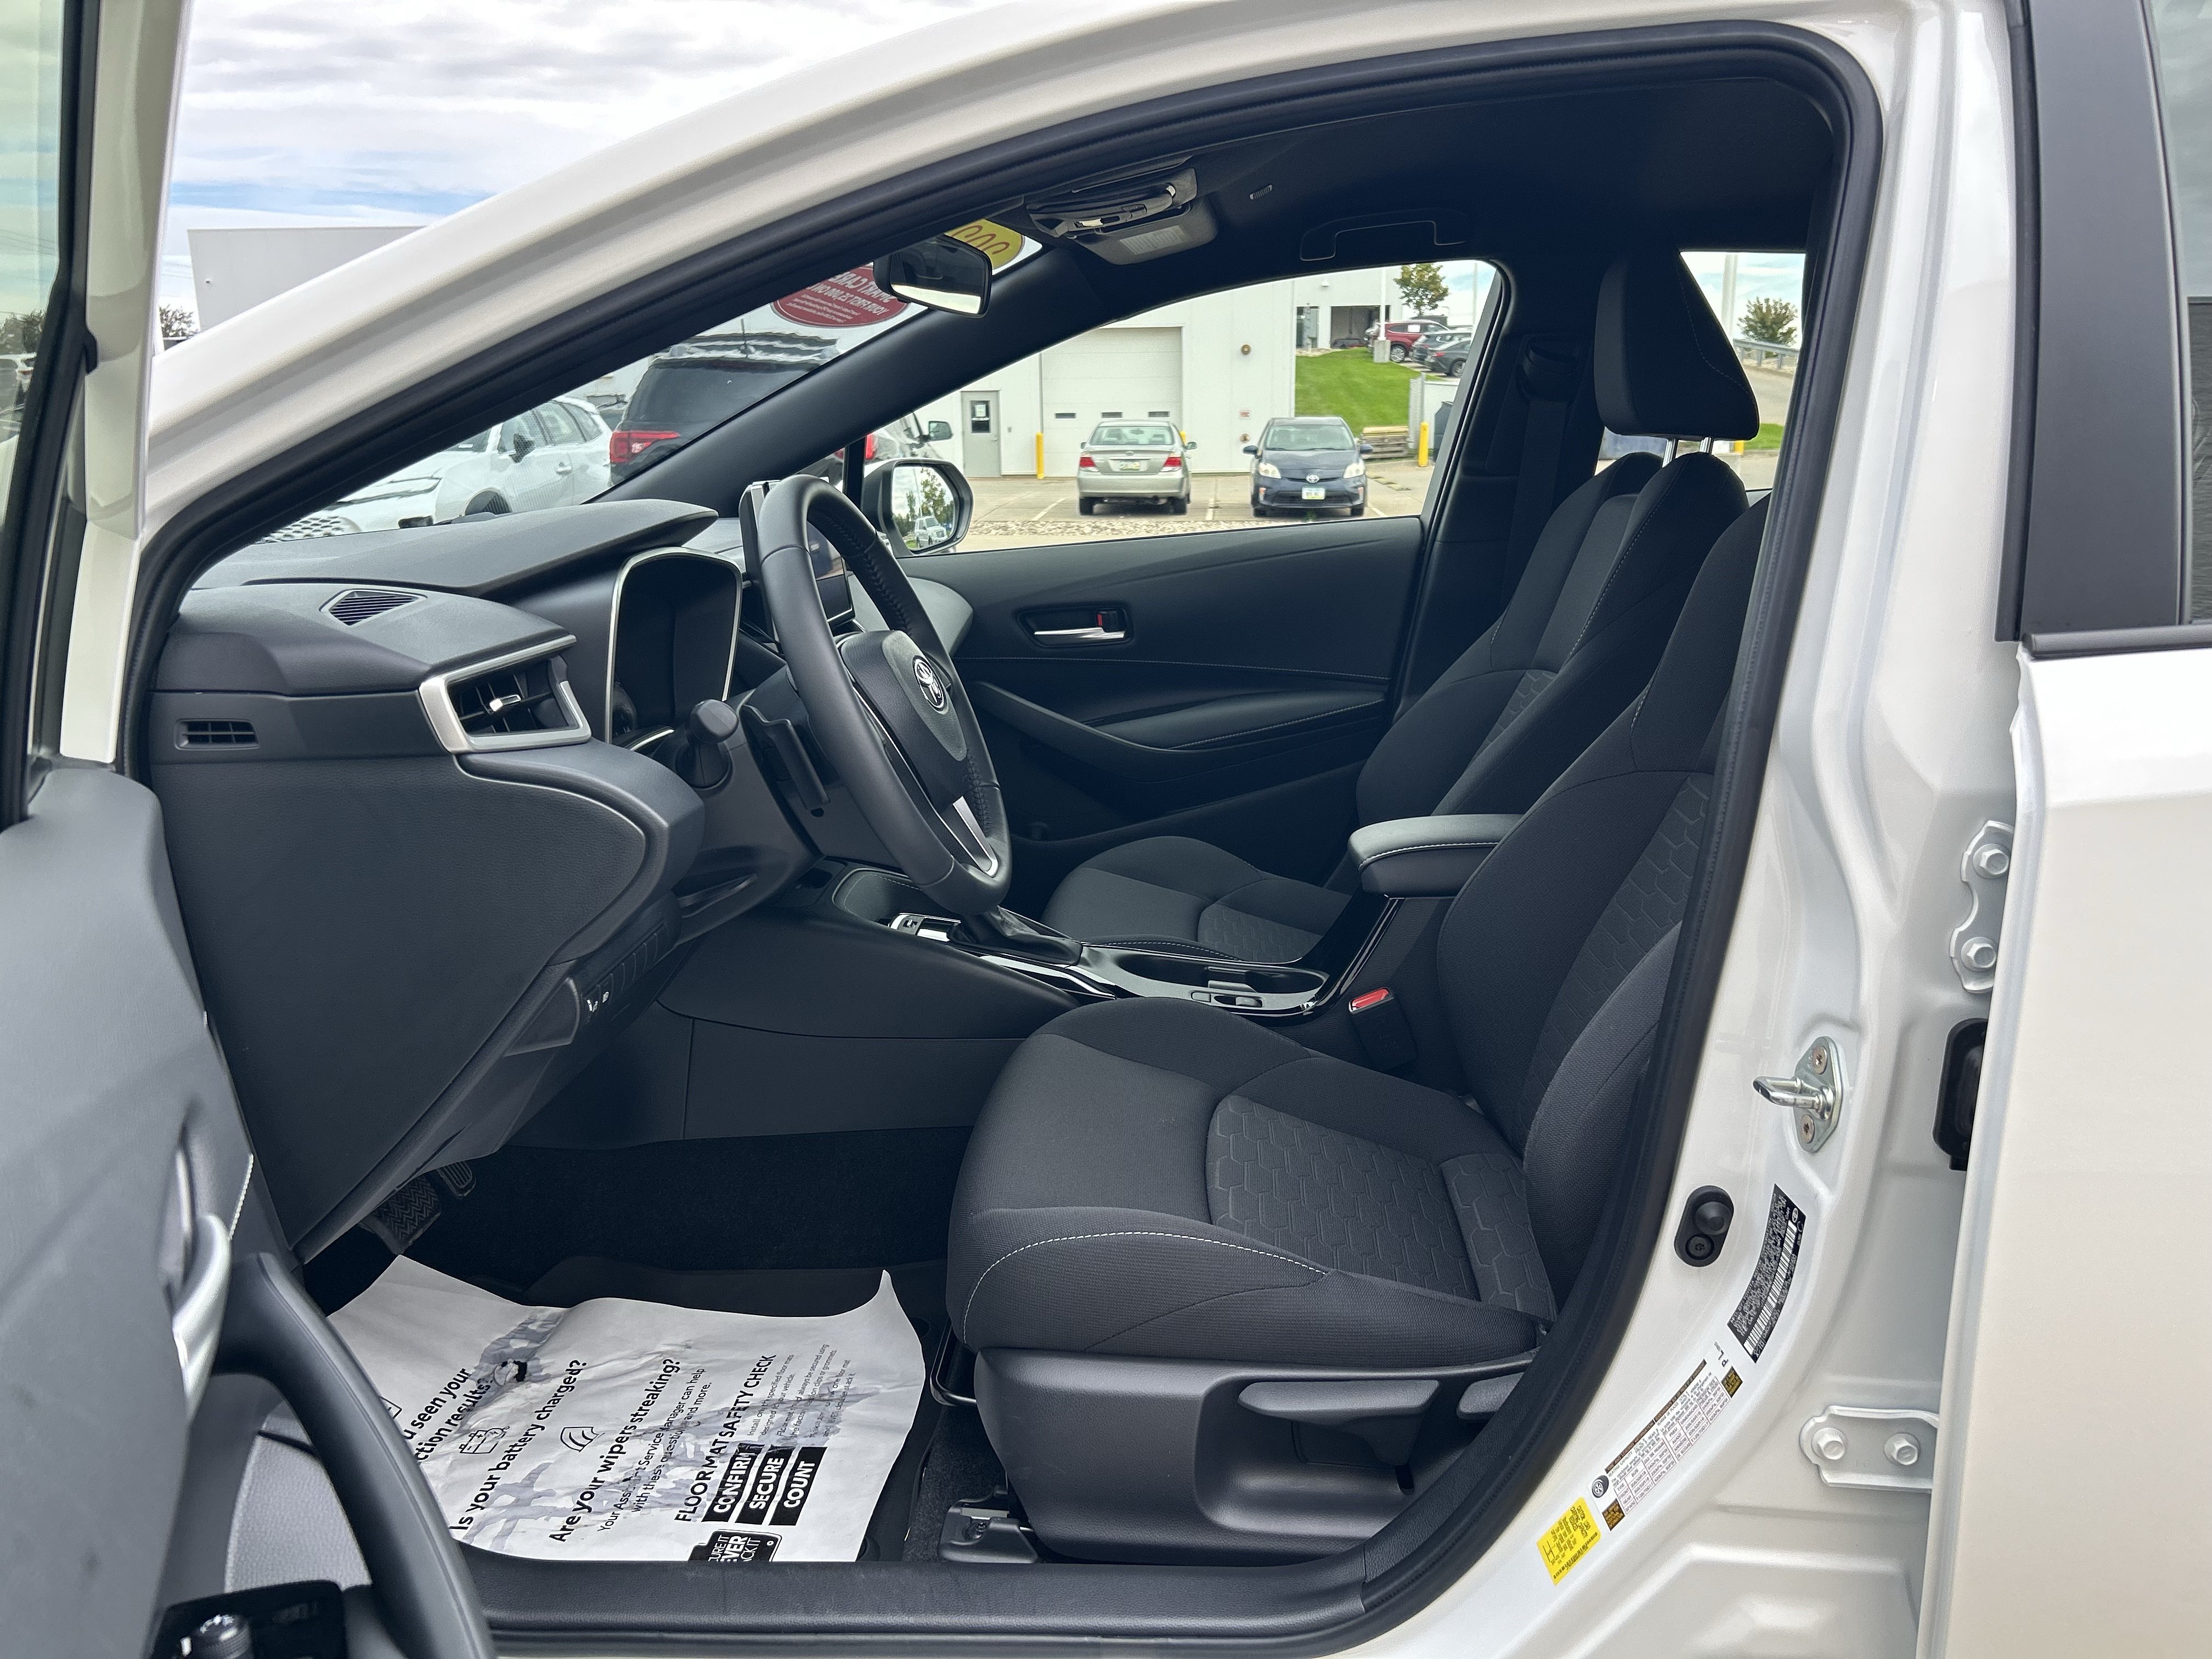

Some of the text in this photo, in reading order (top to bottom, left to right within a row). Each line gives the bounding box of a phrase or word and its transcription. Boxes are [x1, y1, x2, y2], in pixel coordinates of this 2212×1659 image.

[411, 1368, 471, 1429] seen your
[445, 1378, 493, 1426] results?
[746, 1419, 761, 1435] Install
[449, 1359, 587, 1530] Is your battery charged?
[549, 1359, 680, 1542] Are your wipers streaking?
[597, 1511, 620, 1532] Your
[639, 1432, 664, 1466] Service
[681, 1382, 694, 1401] can
[691, 1368, 706, 1384] help
[631, 1487, 648, 1513] with
[684, 1406, 698, 1420] and
[693, 1382, 712, 1404] more.
[674, 1355, 777, 1522] FLOOR MAT SAFETY CHECK
[713, 1452, 757, 1513] CONFIRM
[749, 1457, 785, 1509] SECURE
[783, 1460, 815, 1508] COUNT
[718, 1534, 729, 1542] IT
[747, 1537, 761, 1547] IT
